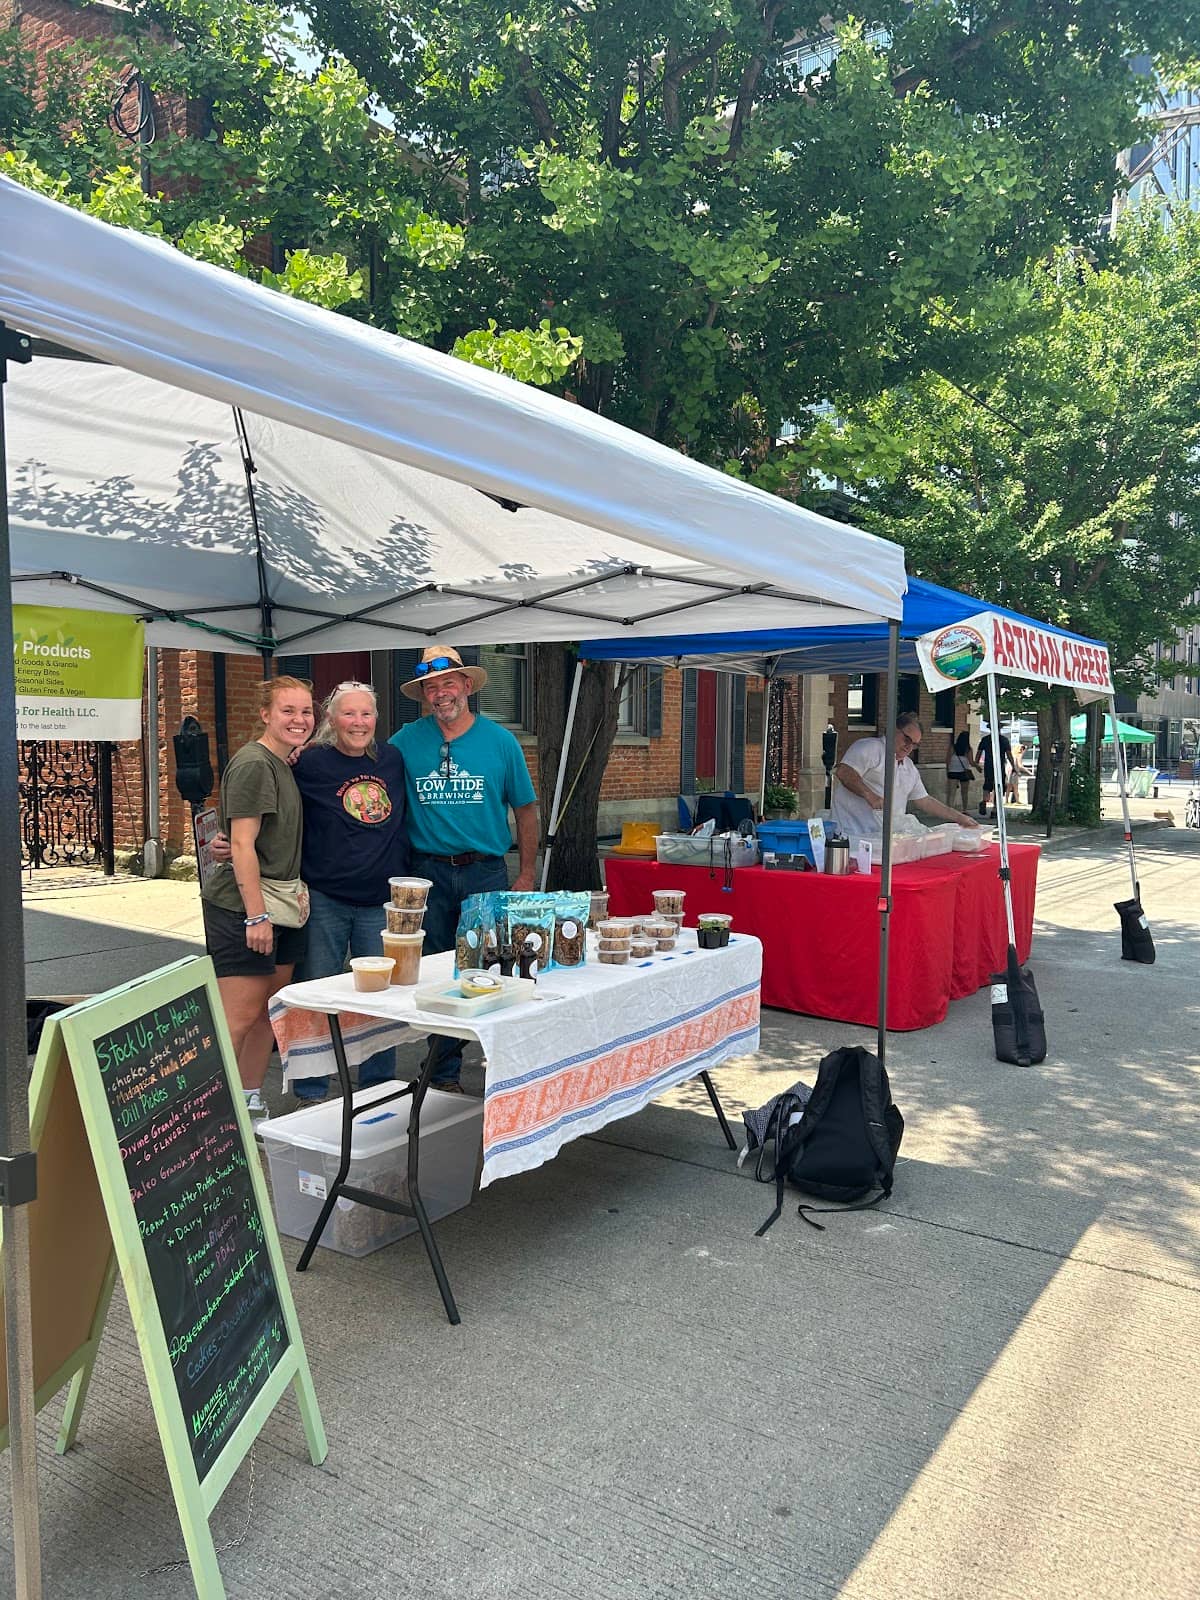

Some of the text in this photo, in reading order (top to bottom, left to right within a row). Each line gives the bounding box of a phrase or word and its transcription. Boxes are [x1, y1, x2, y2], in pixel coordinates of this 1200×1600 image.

[23, 641, 92, 659] Products
[992, 618, 1110, 687] ARTISAN CHEESE
[21, 659, 45, 667] Goods
[53, 660, 79, 668] Granola
[17, 668, 42, 676] Energy
[46, 678, 65, 686] Sides
[19, 686, 86, 696] Gluten Free & Vegan
[23, 707, 40, 716] For
[42, 707, 75, 717] Health
[77, 708, 100, 718] LLC.
[28, 722, 40, 730] the
[41, 722, 53, 730] last
[416, 779, 485, 793] LOW TIDE
[427, 792, 471, 800] BREWING
[96, 1000, 201, 1073] Stock Up for Health
[111, 1064, 148, 1092] chicken
[149, 1044, 172, 1068] stock
[121, 1107, 141, 1128] Dill
[139, 1086, 170, 1115] Pickles
[143, 1152, 152, 1163] 6
[130, 1176, 157, 1202] Paleo
[138, 1208, 170, 1240] Peanut
[171, 1190, 198, 1217] Butter
[173, 1215, 203, 1242] Dairy
